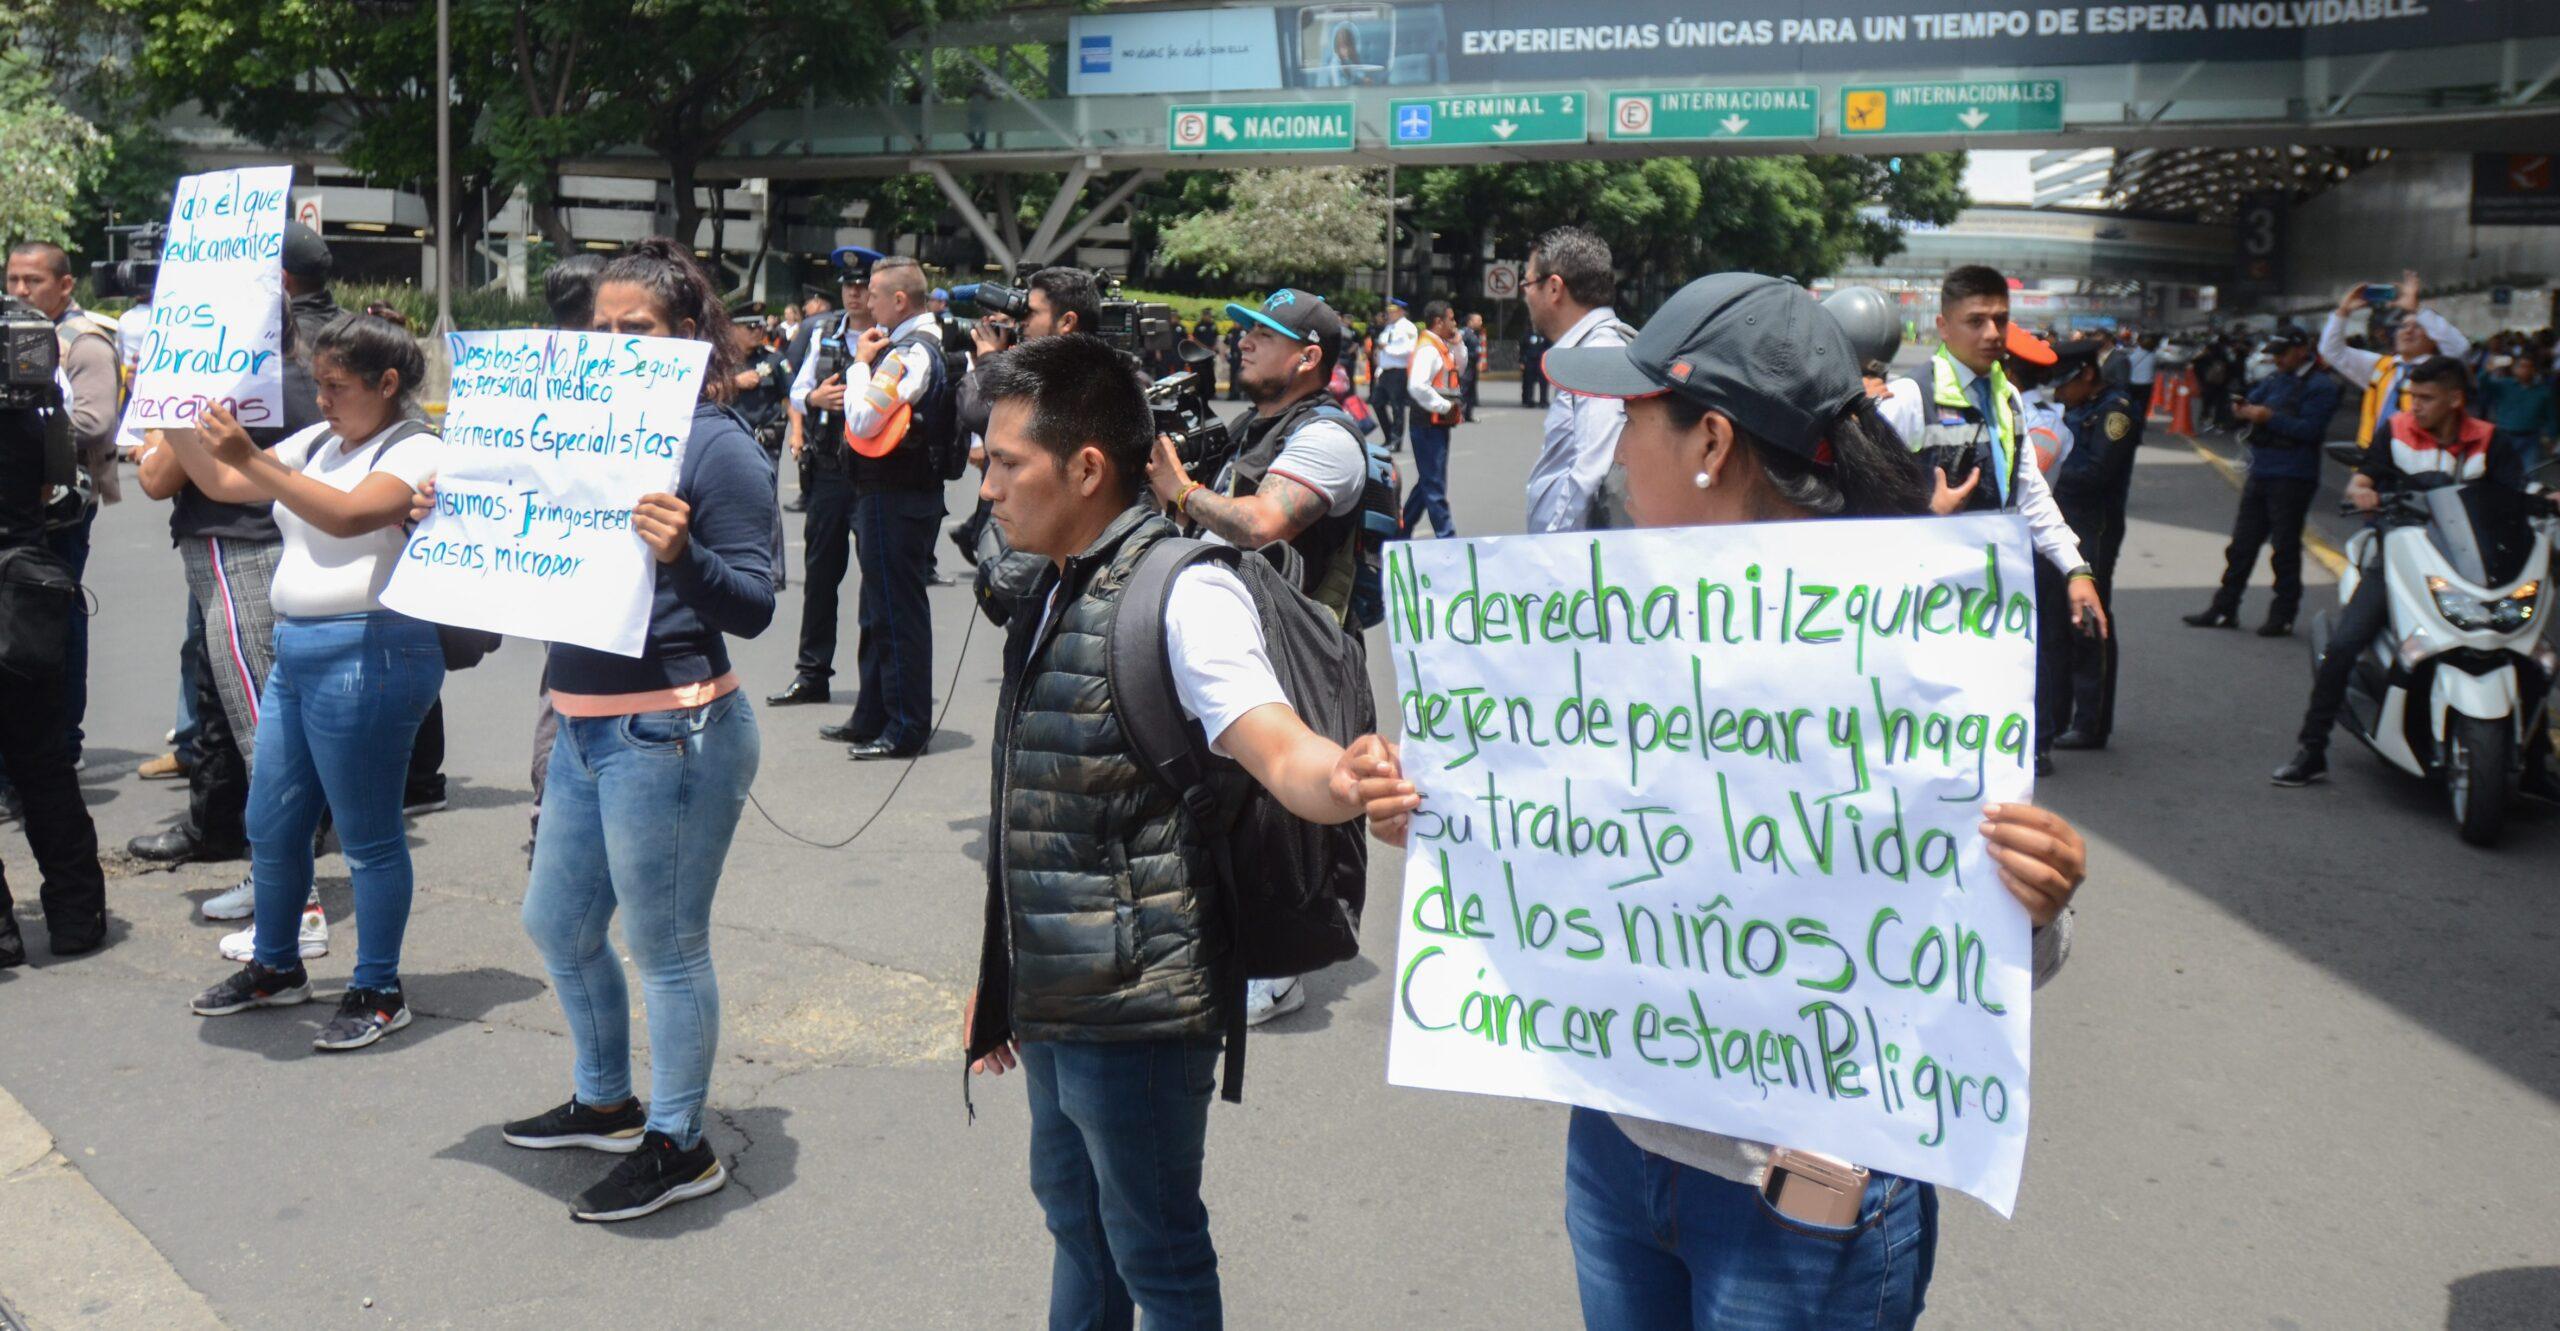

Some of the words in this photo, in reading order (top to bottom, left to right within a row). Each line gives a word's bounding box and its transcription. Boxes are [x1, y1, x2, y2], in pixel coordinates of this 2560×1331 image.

[1462, 24, 1659, 55] EXPERIENCIAS
[1666, 17, 1774, 48] ÚNICAS
[1780, 18, 1857, 44] PARA
[1862, 15, 1906, 42] UN
[1913, 11, 2029, 40] TIEMPO
[2036, 9, 2079, 35] DE
[2086, 4, 2208, 34] ESPERA
[1438, 97, 1545, 118] TERMINAL
[1560, 96, 1574, 114] 2
[1659, 90, 1811, 112] INTERNACIONAL
[1893, 82, 2057, 106] INTERNACIONALES
[1244, 115, 1348, 138] NACIONAL
[243, 189, 284, 233] que
[2248, 209, 2275, 254] 3
[546, 370, 613, 403] médico
[530, 411, 679, 460] Especialistas
[1390, 540, 1434, 645] Ni
[1554, 649, 1613, 747] de
[1628, 654, 1813, 787] pelear
[1815, 705, 1871, 803] y
[1871, 676, 2029, 802] haga
[1716, 771, 1799, 875] la
[1412, 849, 1495, 939] de
[1503, 861, 1604, 961] los
[1618, 894, 1857, 993] niños
[1400, 945, 1619, 1059] Cáncer
[1799, 1000, 2007, 1147] Peligro
